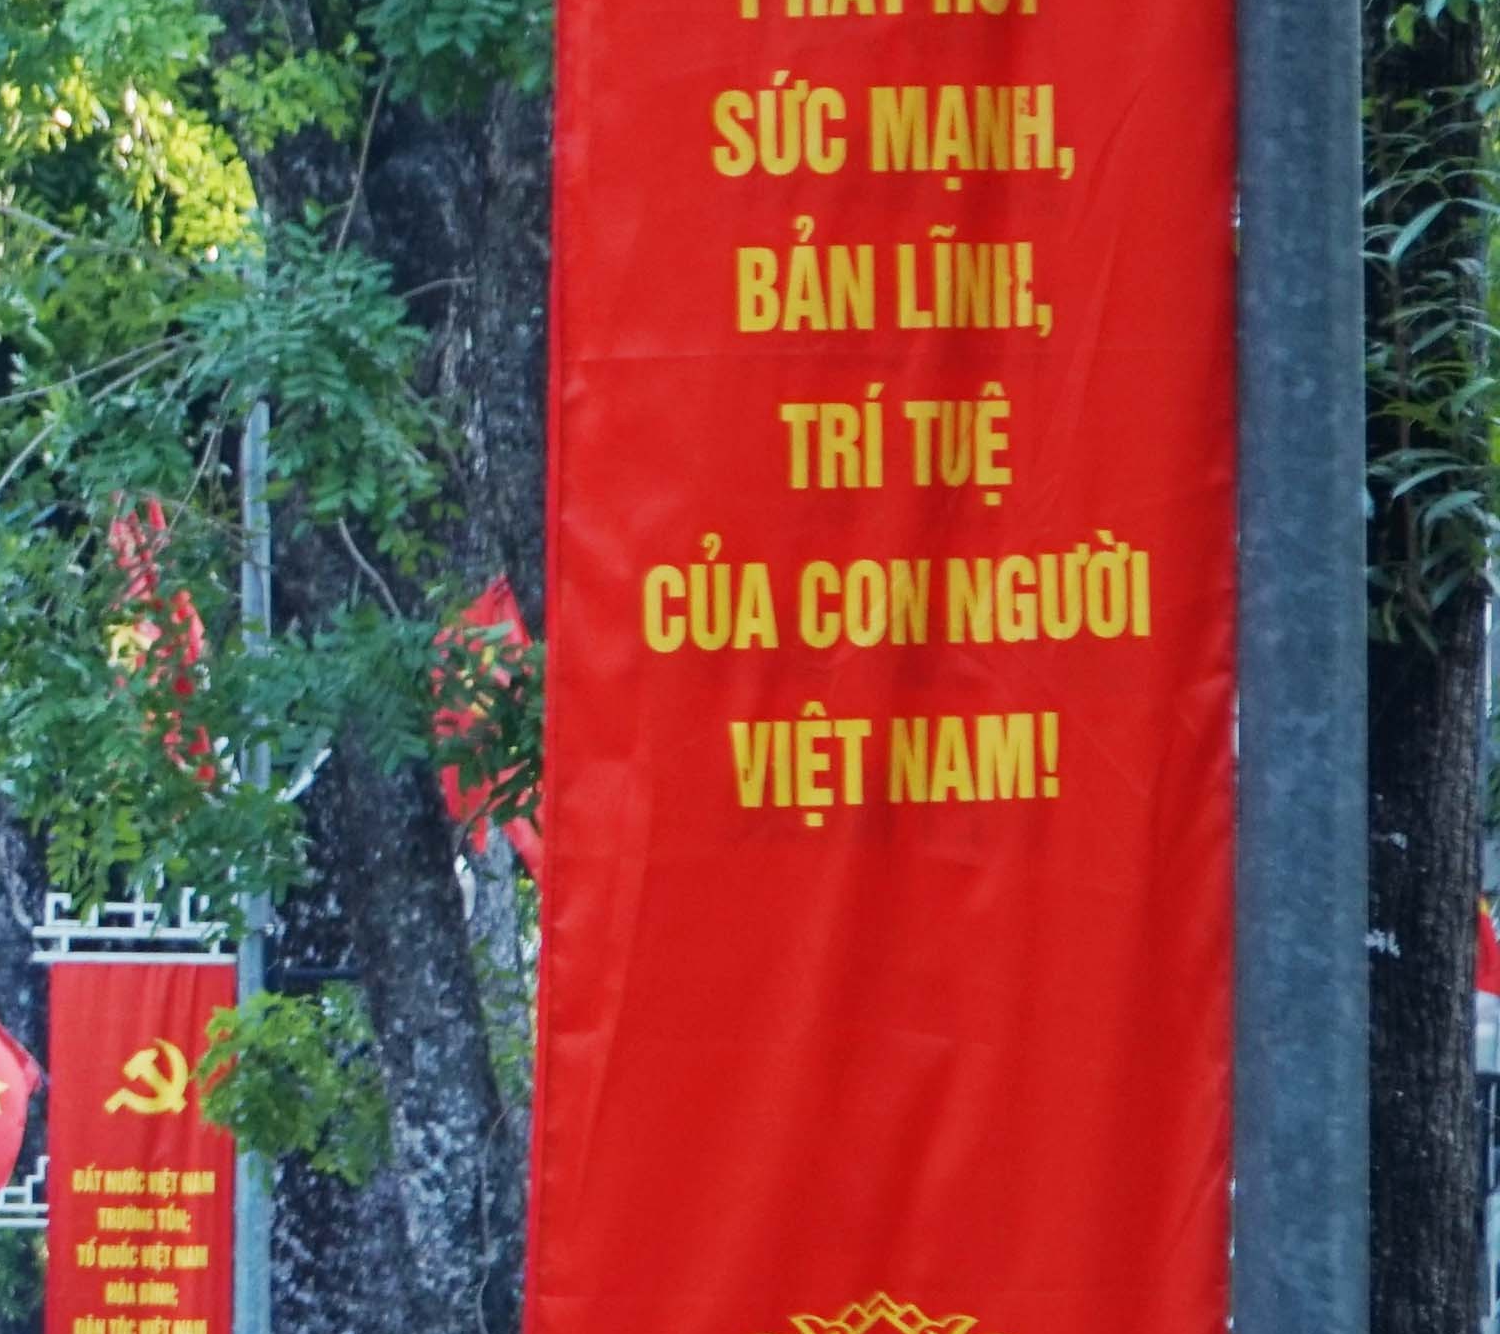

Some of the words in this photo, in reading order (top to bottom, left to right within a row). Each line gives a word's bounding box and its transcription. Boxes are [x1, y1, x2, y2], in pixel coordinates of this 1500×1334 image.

[713, 69, 846, 178] SỨC
[870, 84, 1075, 191] MẠNH,
[737, 214, 874, 333] BẢN
[897, 224, 1052, 337] LĨNH,
[781, 382, 884, 489] TRÍ
[904, 381, 1012, 506] TUỆ
[643, 532, 779, 654] CỦA
[799, 559, 929, 649] CON
[948, 529, 1151, 644] NGƯỜI
[730, 700, 872, 828] VIỆT
[890, 711, 1059, 803] NAM!
